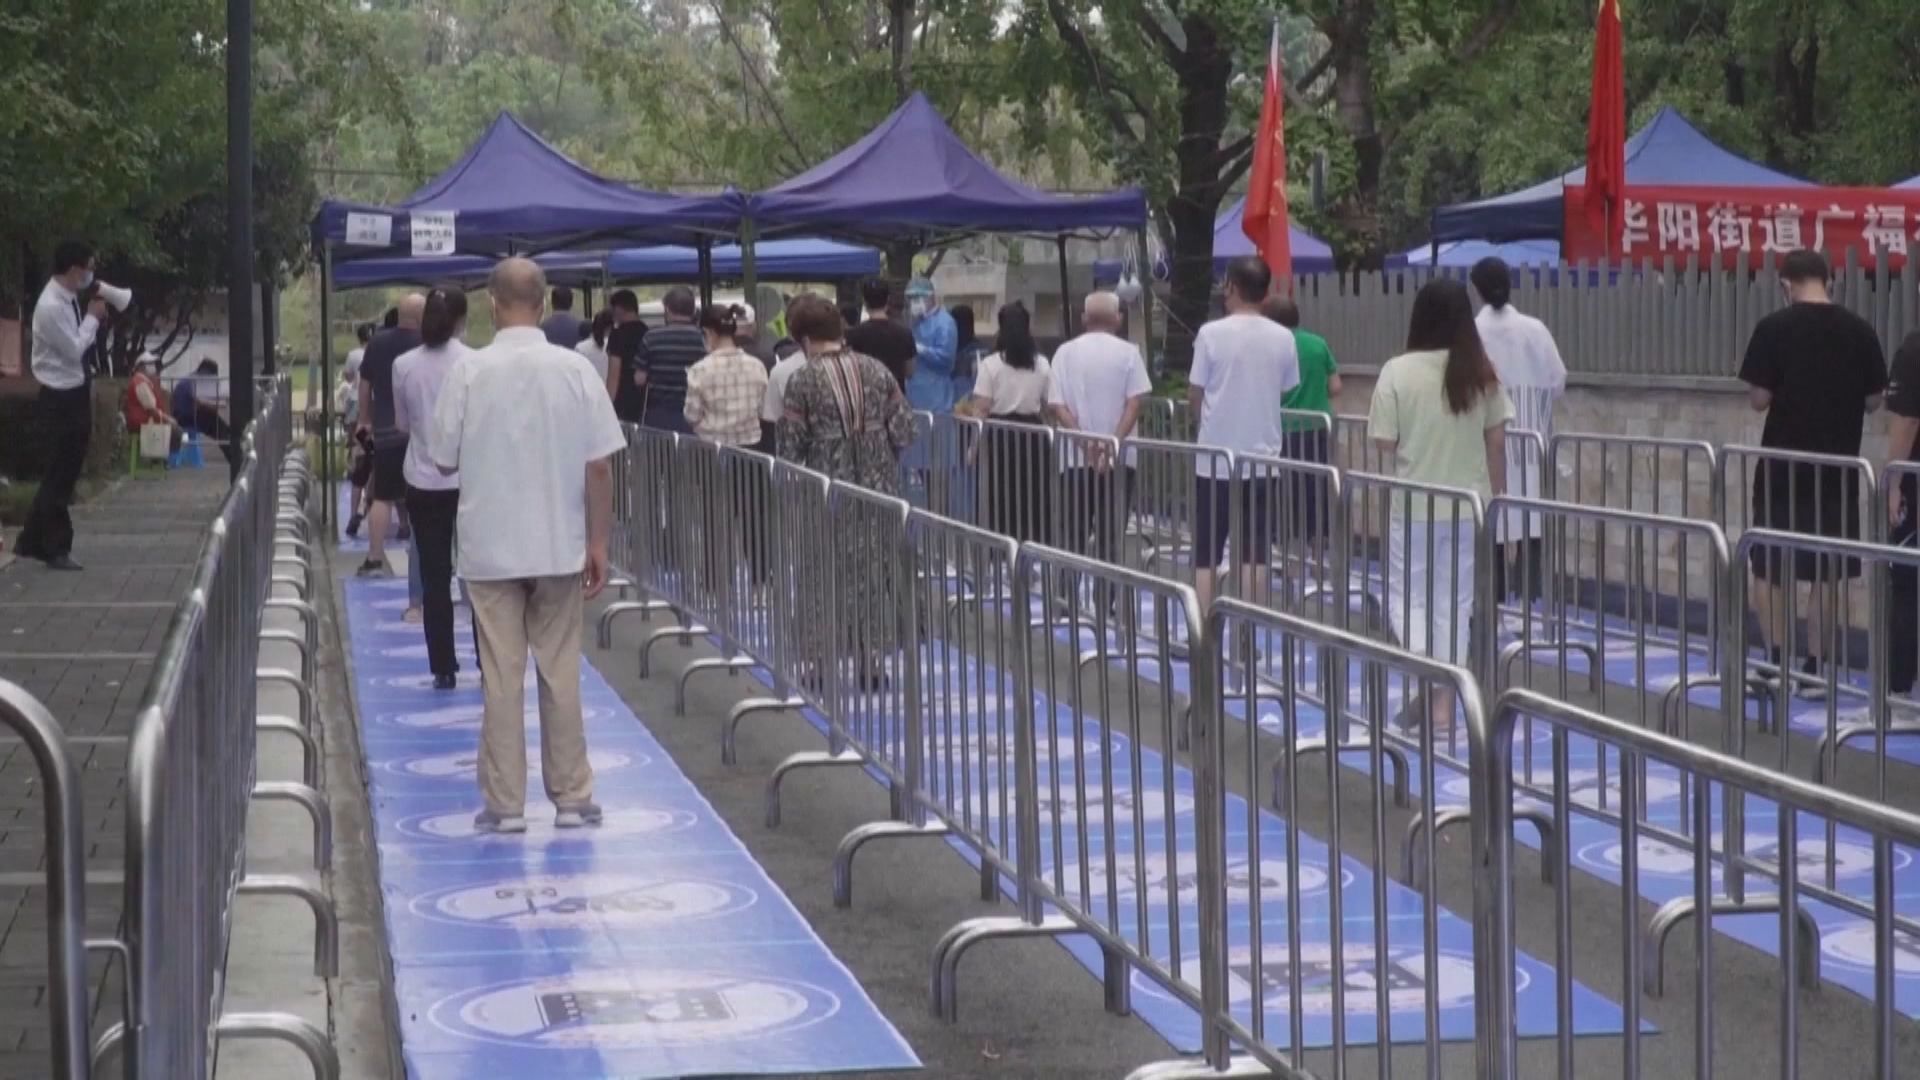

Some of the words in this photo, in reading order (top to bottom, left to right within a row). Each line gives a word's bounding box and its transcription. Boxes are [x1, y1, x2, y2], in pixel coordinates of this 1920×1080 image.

[1622, 198, 1920, 255] 华阳街道广福
